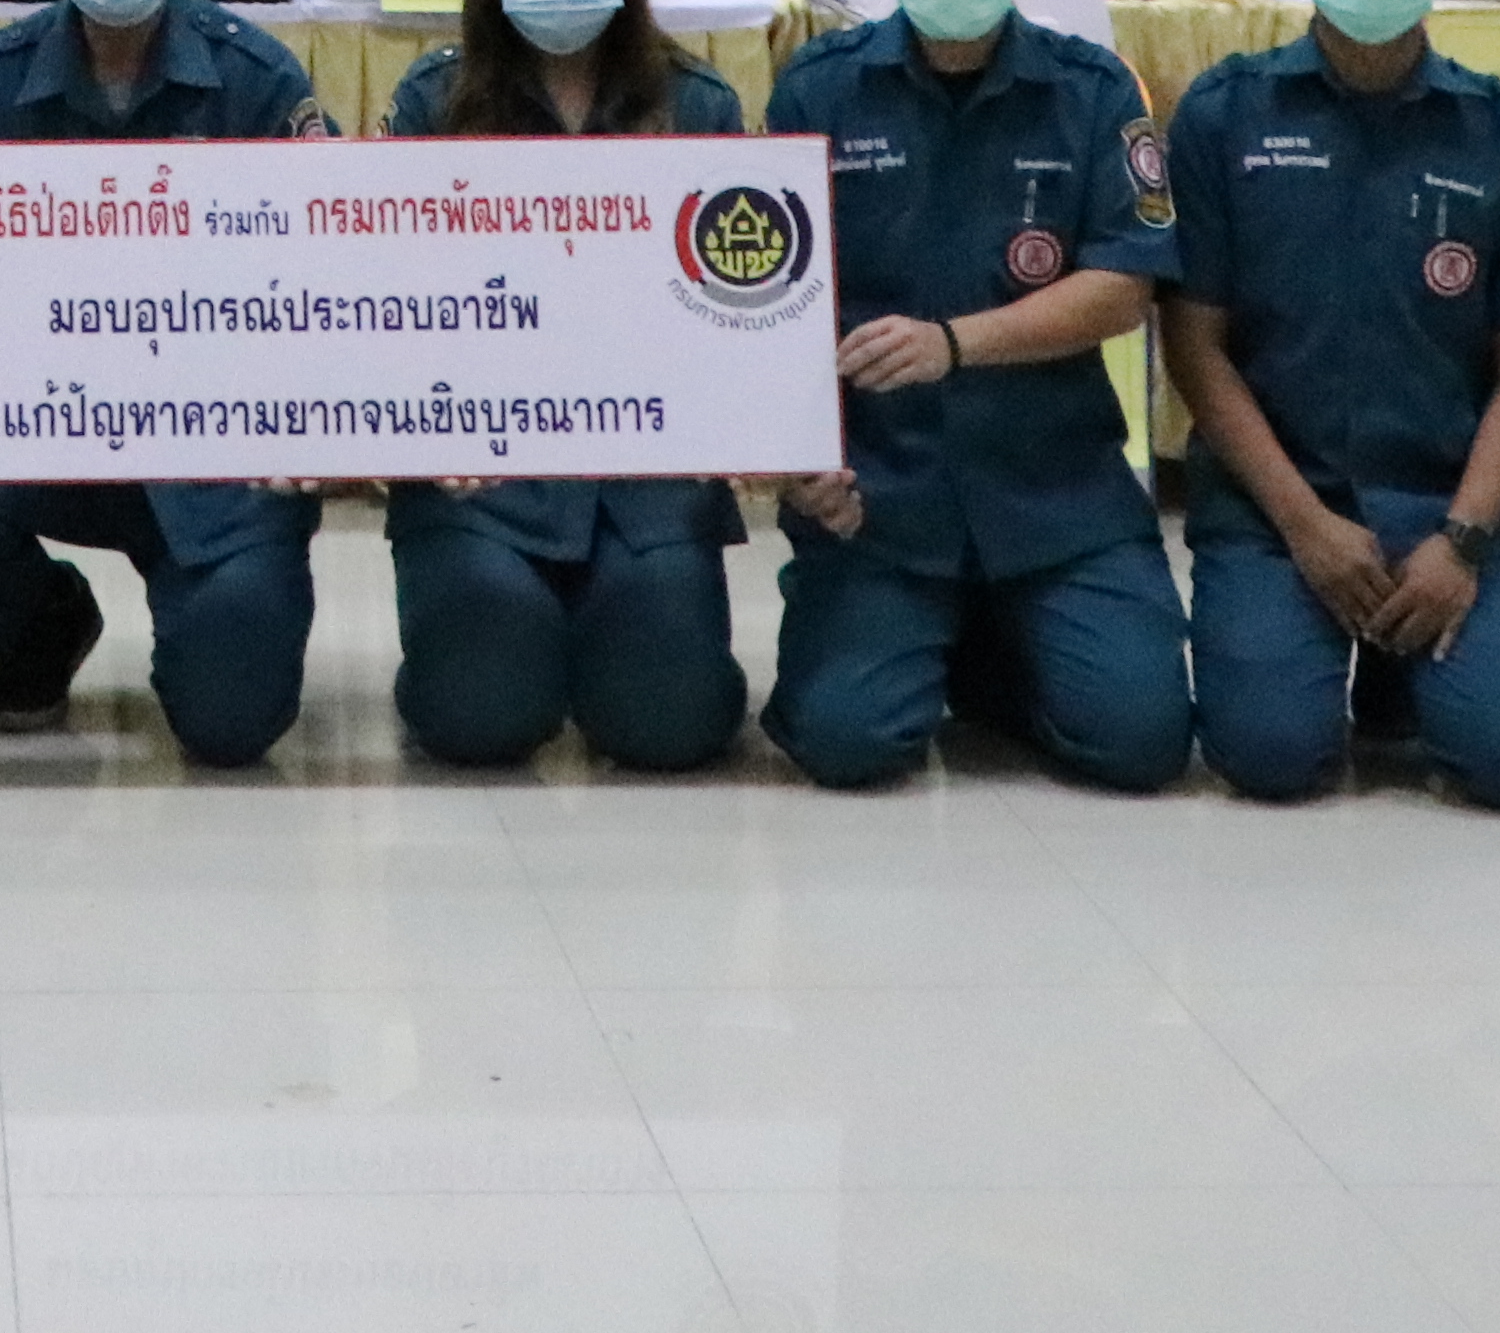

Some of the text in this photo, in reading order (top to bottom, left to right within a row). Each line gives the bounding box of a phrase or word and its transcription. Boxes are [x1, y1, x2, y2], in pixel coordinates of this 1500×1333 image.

[205, 199, 290, 236] ร่วมกับ
[307, 179, 652, 257] กรมการพัฒนาชุมชน
[50, 277, 540, 356] มอบอุปกรณ์ประกอบอาชีพ
